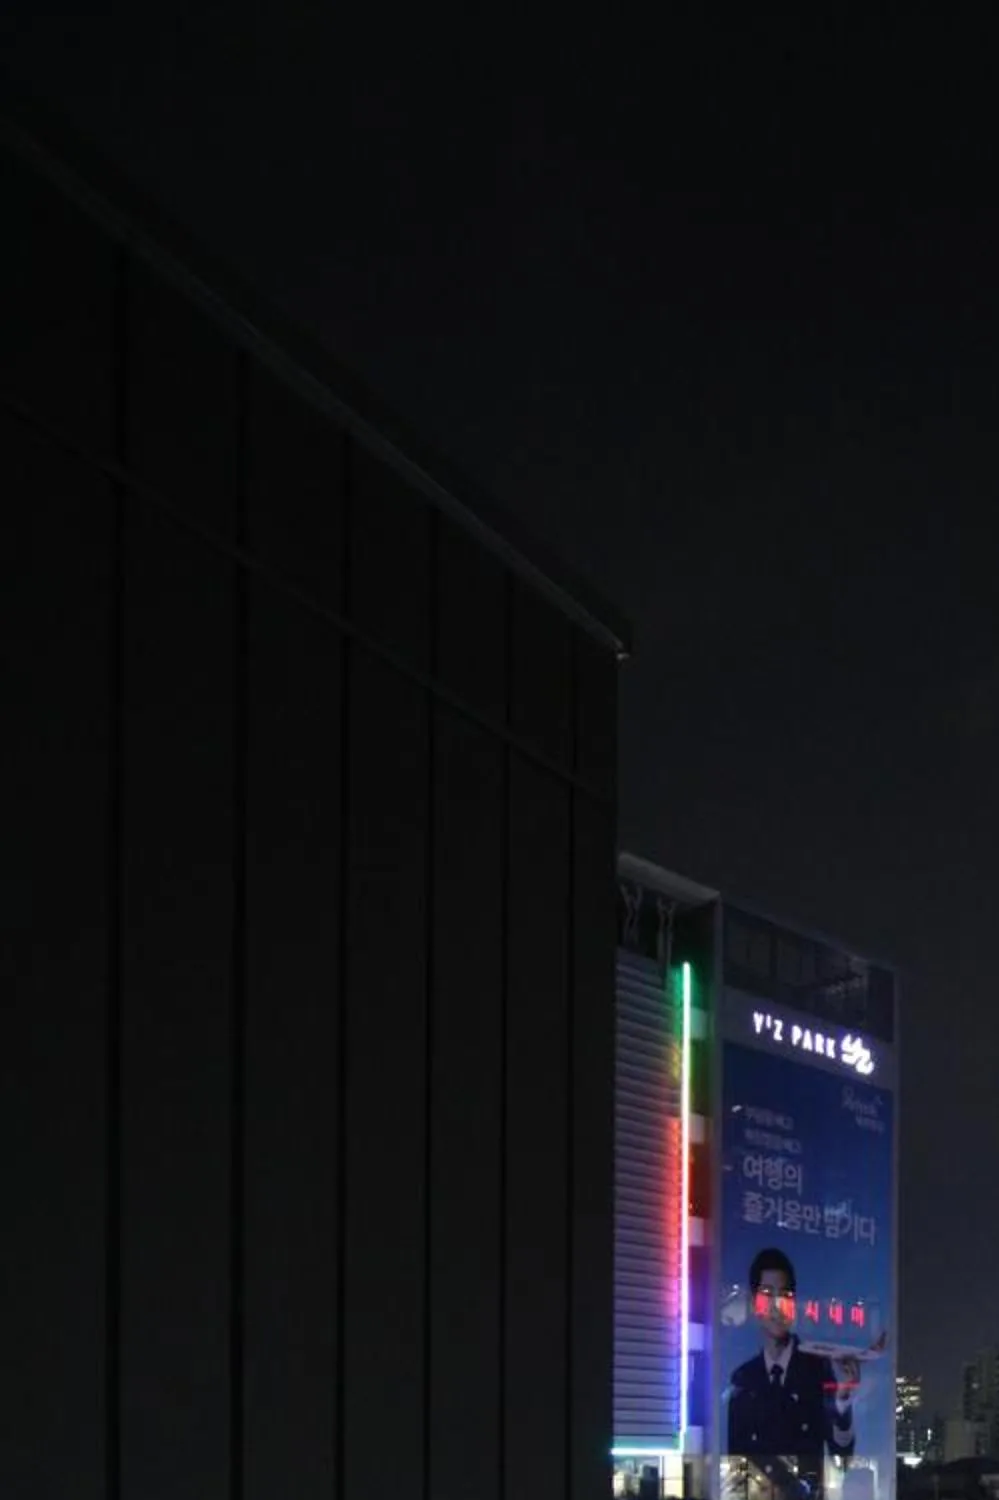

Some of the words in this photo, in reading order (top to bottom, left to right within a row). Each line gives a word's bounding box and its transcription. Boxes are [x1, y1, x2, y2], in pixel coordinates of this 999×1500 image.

[791, 1025, 836, 1059] PARK
[742, 1154, 803, 1196] 여행의
[741, 1190, 822, 1235] 즐거움만
